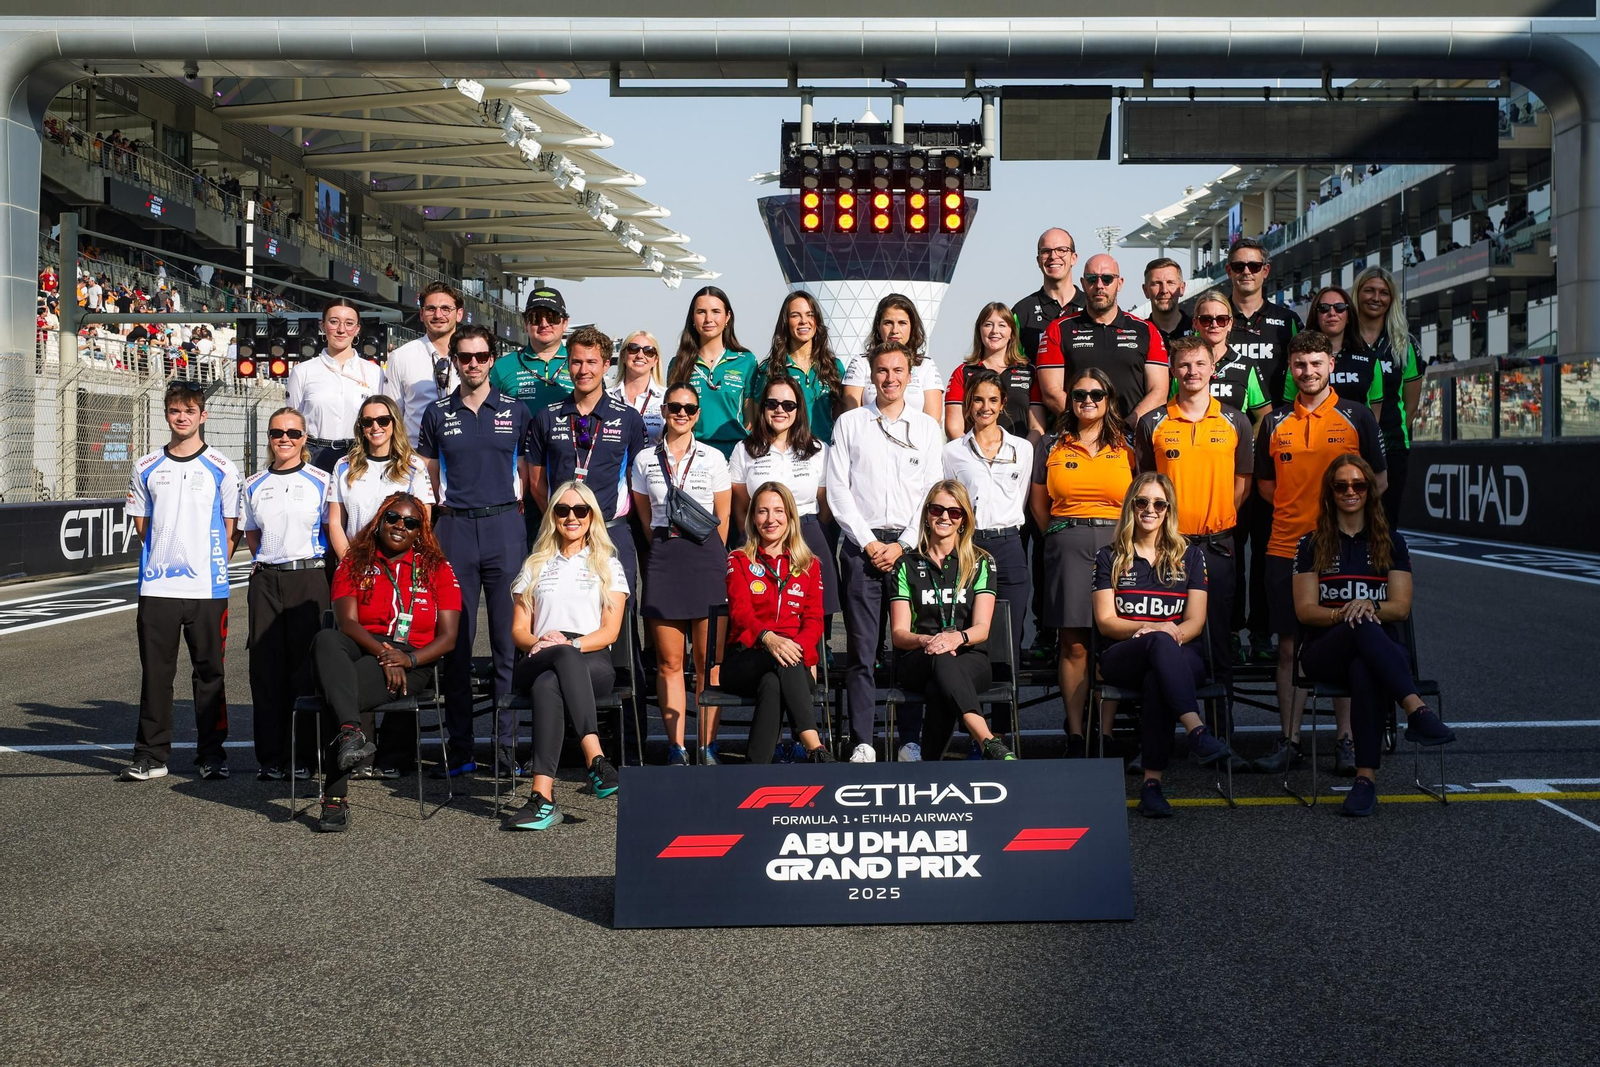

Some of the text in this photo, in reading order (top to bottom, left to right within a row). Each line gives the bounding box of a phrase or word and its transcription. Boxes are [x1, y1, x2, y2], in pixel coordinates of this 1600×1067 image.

[1265, 318, 1285, 327] KICK
[1351, 354, 1369, 363] KICK
[1329, 372, 1359, 384] ICK
[1210, 383, 1233, 397] CK
[449, 420, 462, 428] MSC
[1278, 439, 1292, 447] DELL
[139, 455, 158, 467] HUGO
[208, 453, 227, 466] HUGO
[1425, 464, 1529, 526] ETIHAD
[60, 507, 144, 561] ETIHA
[211, 529, 227, 584] Red Bull
[1320, 581, 1388, 601] Red Bull
[1115, 596, 1185, 616] Red Bull
[737, 785, 825, 809] F1
[835, 782, 1008, 807] ETIHAD
[772, 812, 974, 825] FORMULA 1 ETIHAD AIRWAYS
[779, 830, 968, 856] ABU DHABI
[765, 855, 982, 881] GRAND PRIX
[848, 887, 901, 900] 2025
